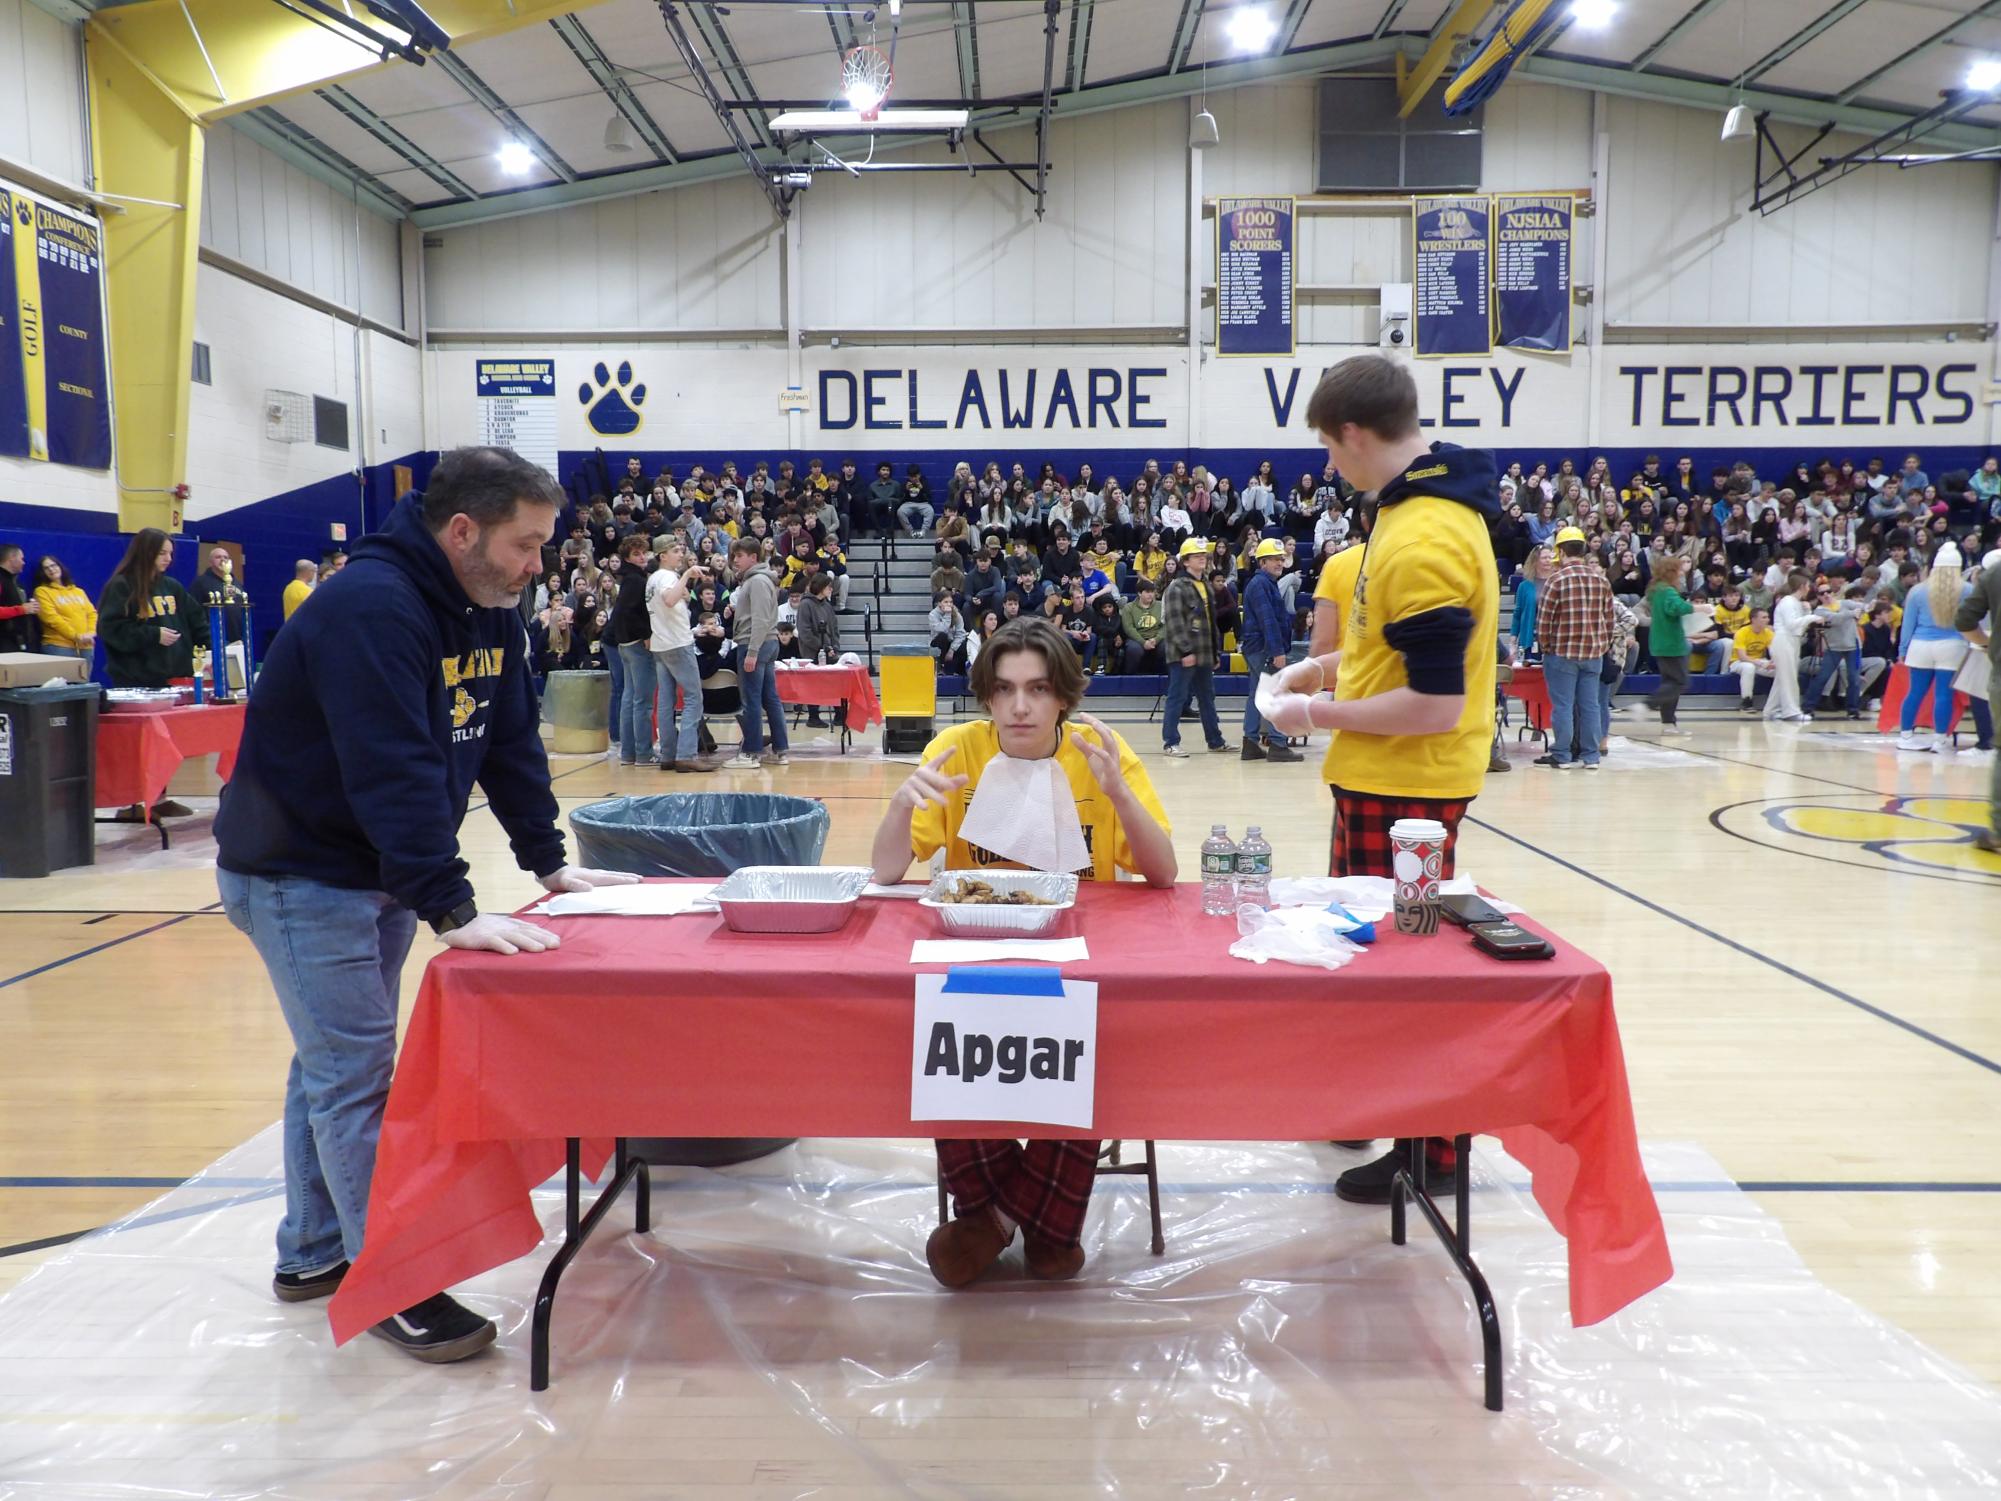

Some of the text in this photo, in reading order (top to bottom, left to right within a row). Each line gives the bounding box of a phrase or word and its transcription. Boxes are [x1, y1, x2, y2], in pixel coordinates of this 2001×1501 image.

[1221, 200, 1292, 217] DELAWARE VALLEY
[1417, 200, 1488, 217] DELAWARE VALLEY
[1500, 198, 1570, 216] DELAWARE VALLEY
[1237, 211, 1275, 226] 1000
[1438, 211, 1466, 227] 100
[1506, 213, 1562, 228] NJSIAA
[37, 207, 97, 252] CHAMPIONS
[1238, 228, 1275, 240] POINT
[1500, 230, 1569, 241] CHAMPIONS
[45, 231, 90, 256] CONFERENCE
[1230, 240, 1282, 251] SCORERS
[1419, 240, 1486, 251] WRESTLERS
[23, 299, 38, 356] GOLF
[59, 324, 89, 340] COUNTY
[500, 386, 533, 394] VOLLEYBALL
[819, 364, 1977, 429] DELAWARE VEY TERRIERS
[924, 1021, 1085, 1084] Apgar
